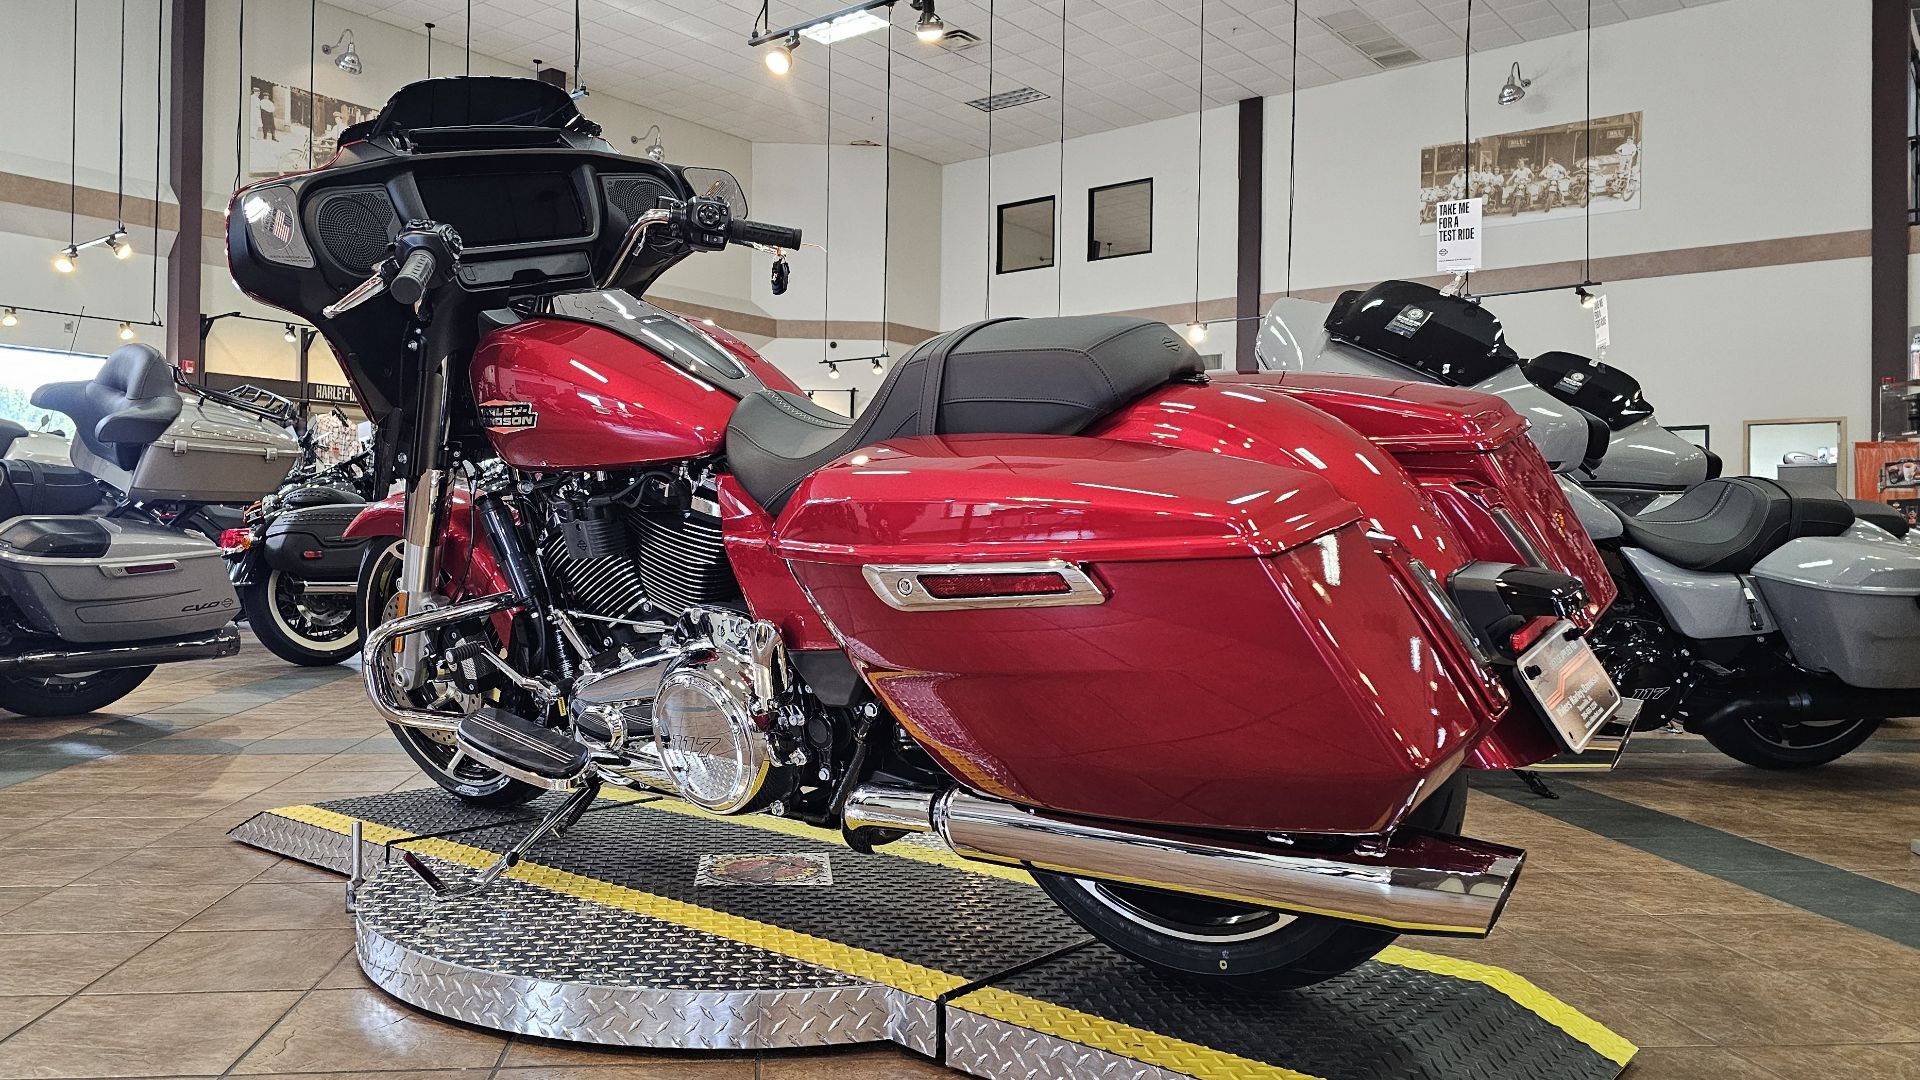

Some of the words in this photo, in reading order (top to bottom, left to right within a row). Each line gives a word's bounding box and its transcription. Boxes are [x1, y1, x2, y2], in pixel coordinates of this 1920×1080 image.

[1439, 203, 1457, 216] TAKE
[1458, 202, 1470, 214] ME
[1439, 217, 1453, 229] FOR
[1454, 216, 1459, 228] A
[1439, 229, 1456, 242] TEST
[1457, 227, 1475, 240] RIDE
[316, 385, 357, 402] HARLEY-D
[181, 601, 220, 612] CVO
[1631, 687, 1671, 700] 117
[672, 734, 722, 757] 117
